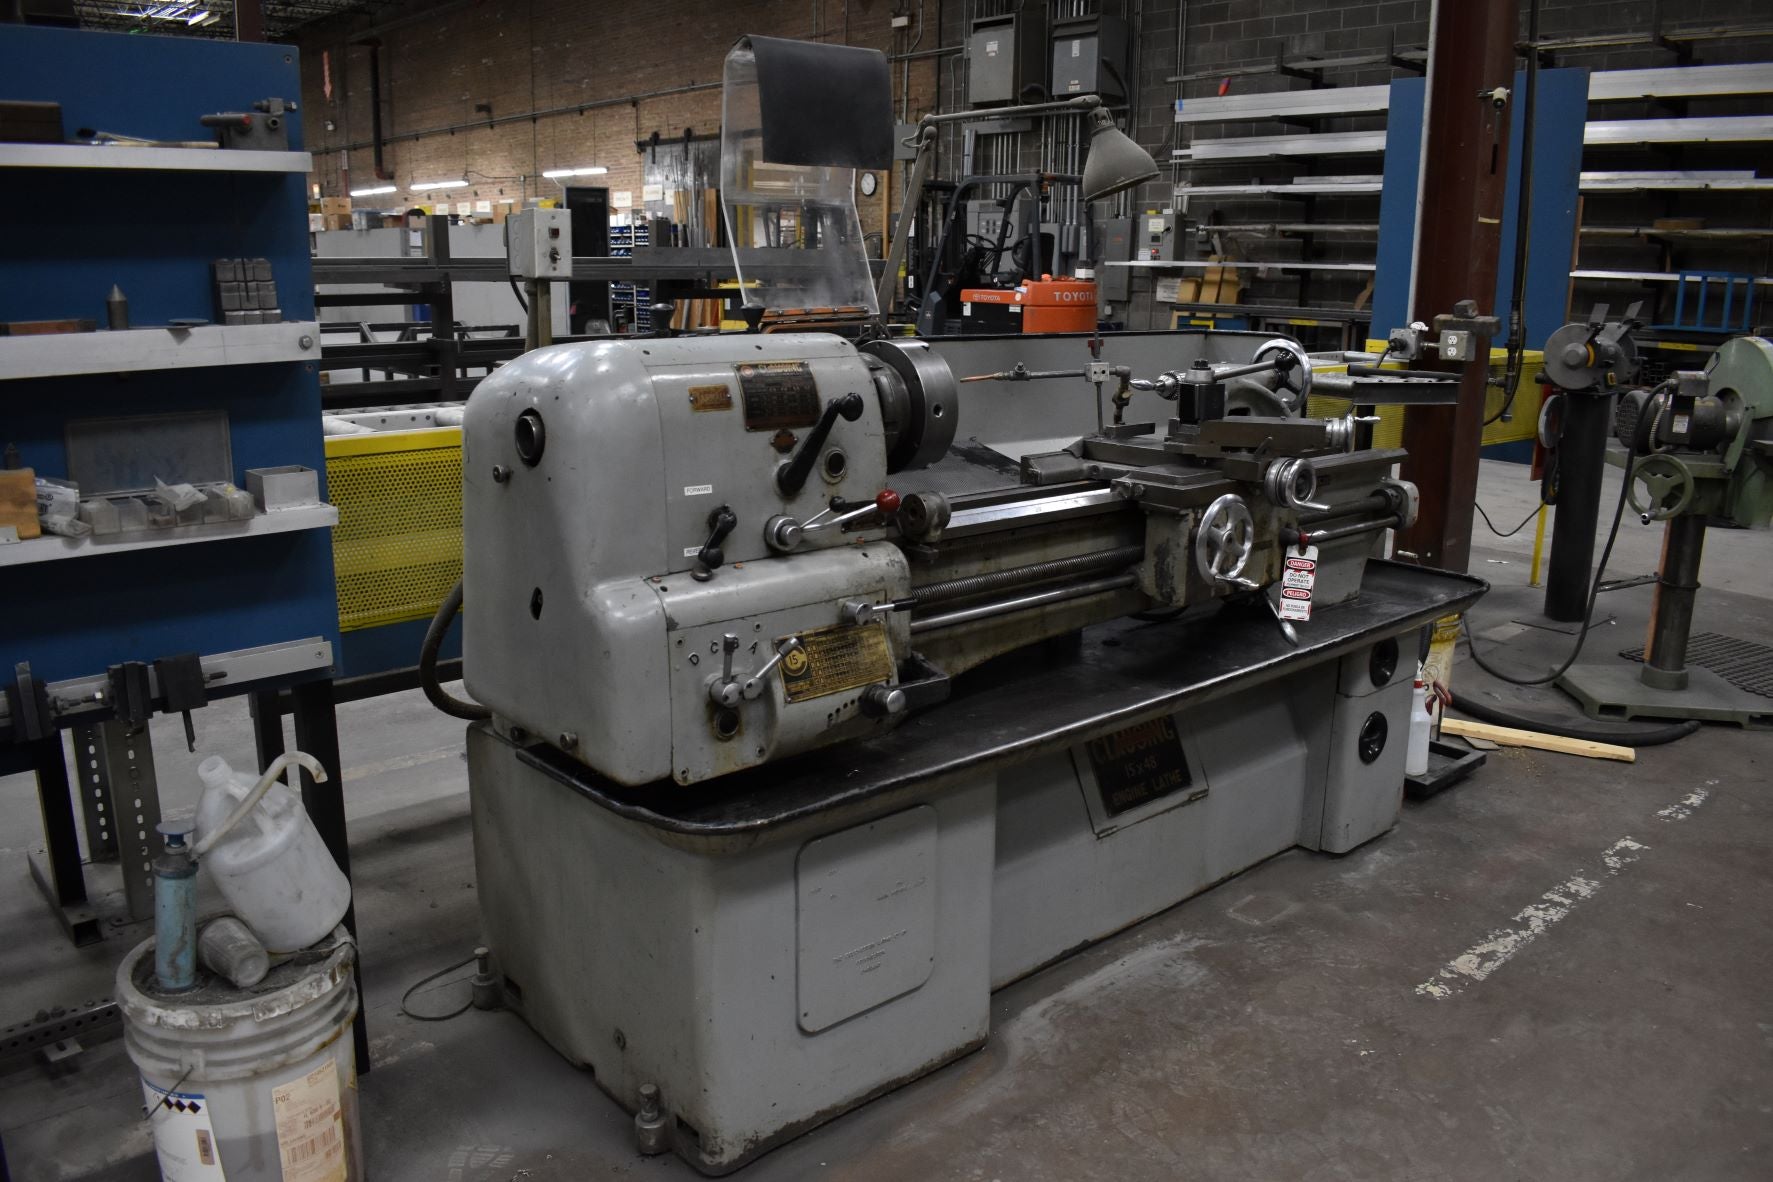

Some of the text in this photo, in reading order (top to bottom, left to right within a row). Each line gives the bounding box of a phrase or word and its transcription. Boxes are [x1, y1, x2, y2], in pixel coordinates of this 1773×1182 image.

[686, 486, 711, 494] FORWARD
[1290, 561, 1311, 569] DANGER
[1287, 577, 1310, 585] OPERATE
[688, 652, 700, 666] D
[710, 641, 719, 654] C
[748, 641, 759, 655] A
[788, 654, 799, 666] 15
[1091, 717, 1175, 765] CLAUSING
[1151, 769, 1183, 791] LATHE
